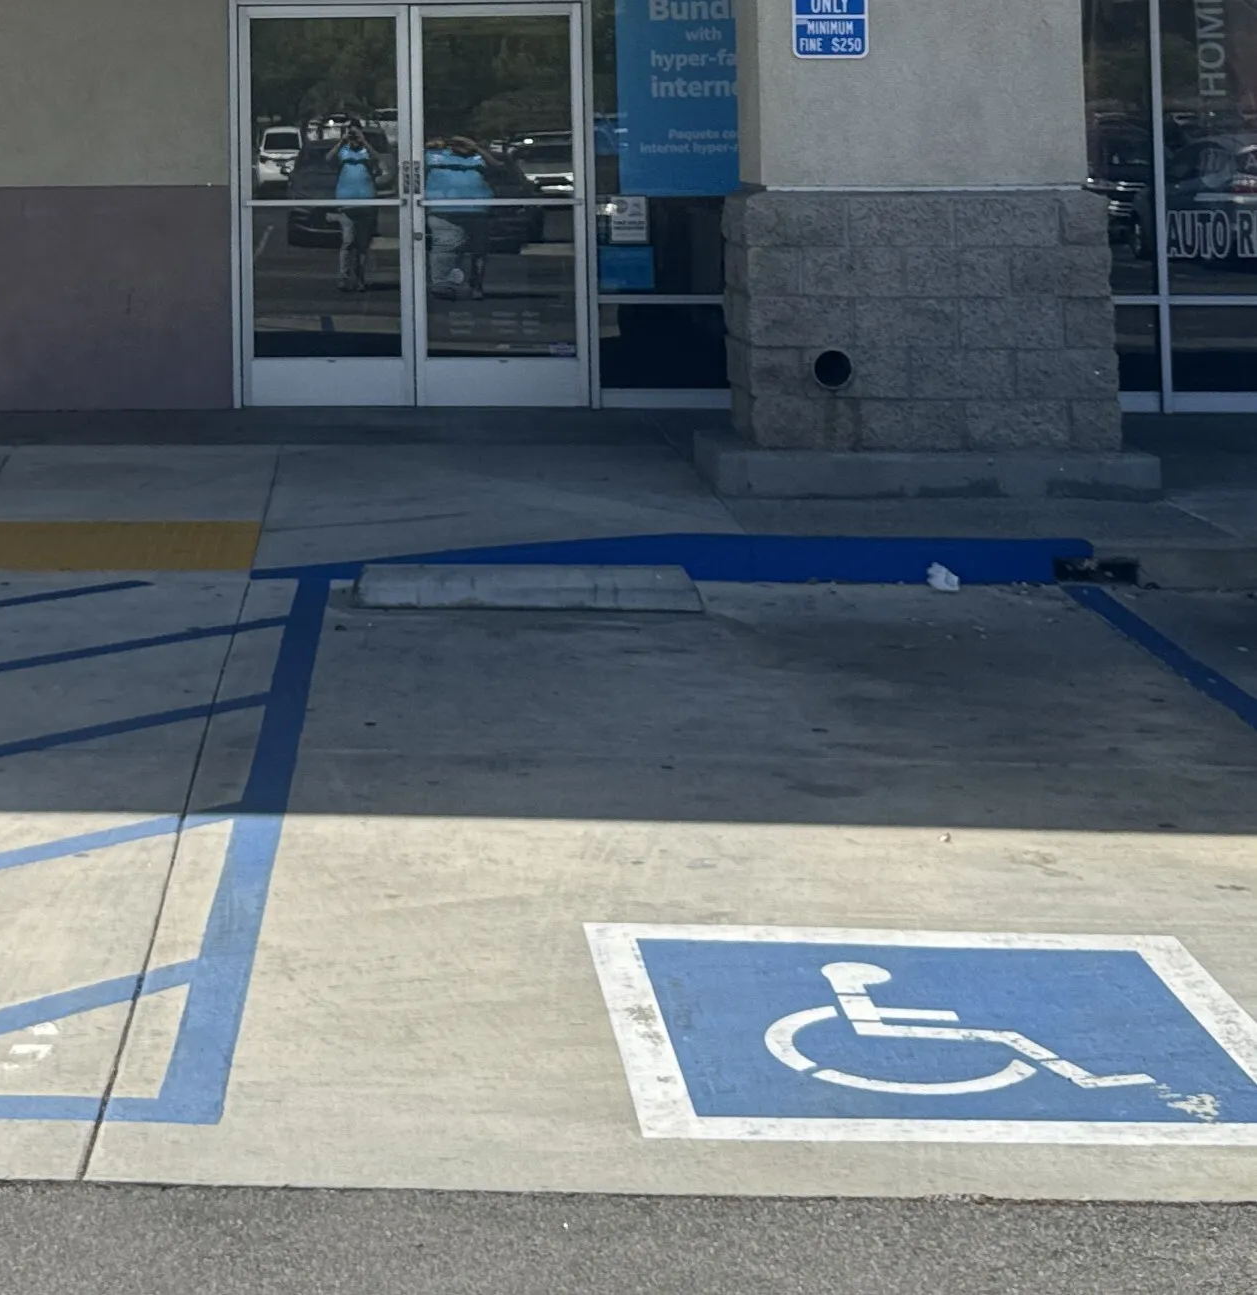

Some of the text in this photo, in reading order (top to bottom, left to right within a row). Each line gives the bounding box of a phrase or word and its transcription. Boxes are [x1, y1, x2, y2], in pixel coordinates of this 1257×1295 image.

[685, 26, 722, 41] with
[806, 20, 854, 35] MINIMUM
[799, 37, 862, 52] FINE $250
[1166, 210, 1257, 258] AUTO R
